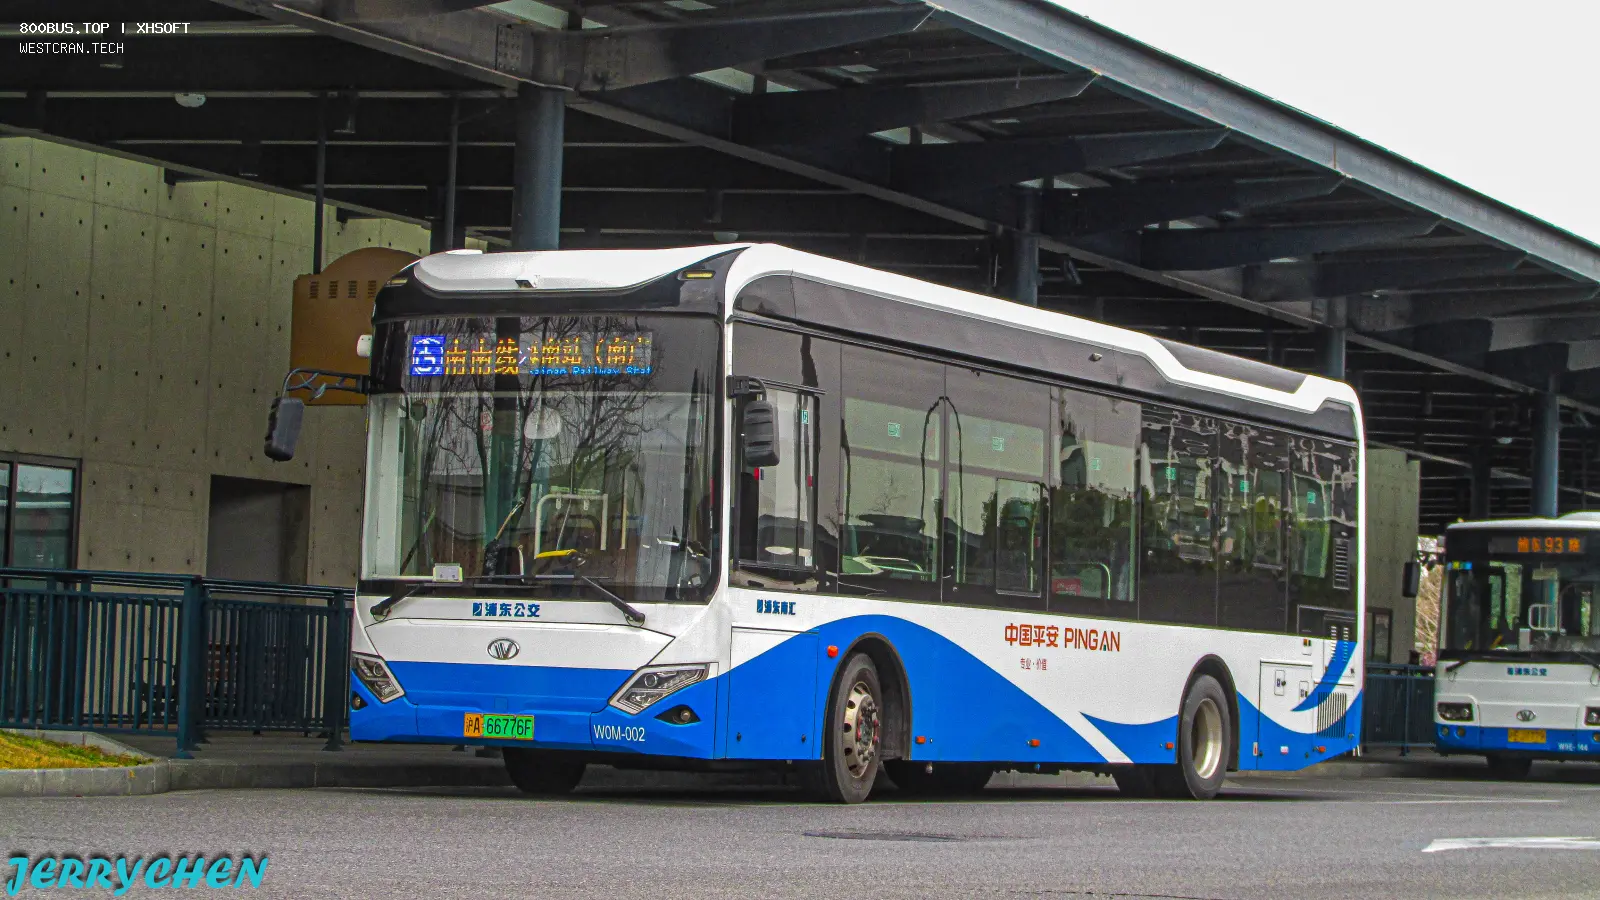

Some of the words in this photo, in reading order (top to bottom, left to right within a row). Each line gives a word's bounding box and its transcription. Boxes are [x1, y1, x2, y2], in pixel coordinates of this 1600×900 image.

[484, 602, 540, 617] 浦东公交
[1004, 623, 1059, 648] 中国平安
[1064, 627, 1121, 652] PINGAN
[486, 718, 532, 736] 66776F
